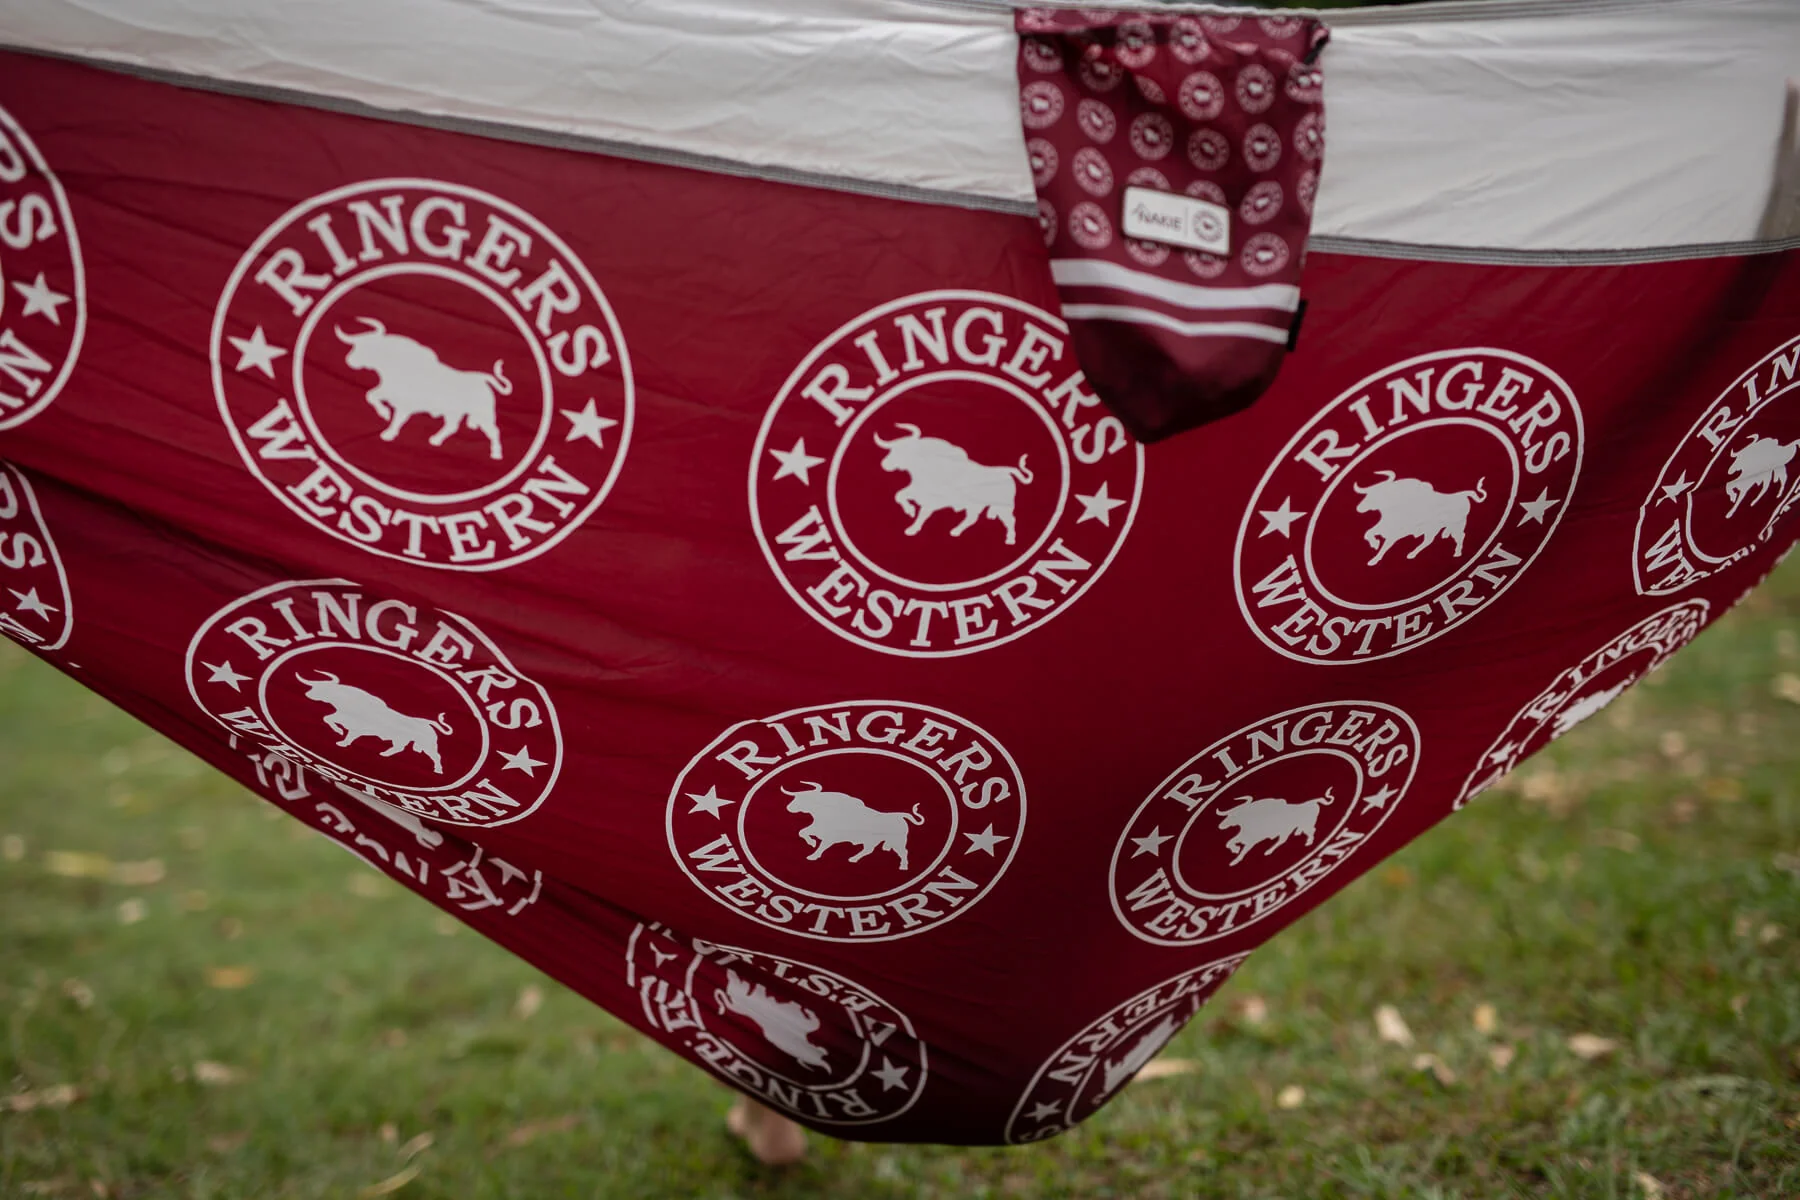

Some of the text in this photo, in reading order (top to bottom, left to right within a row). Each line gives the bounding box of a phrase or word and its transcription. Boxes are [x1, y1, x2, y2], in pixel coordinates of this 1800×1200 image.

[256, 195, 611, 377] RINGERS
[801, 306, 1128, 464] RINGERS
[1295, 361, 1571, 483] RINGERS
[246, 399, 590, 563] WESTERN
[775, 505, 1092, 648] WESTERN
[1251, 542, 1523, 657] WESTERN
[225, 591, 543, 732] RINGERS
[218, 706, 521, 823] WESTERN
[716, 710, 1011, 810] RINGERS
[1163, 710, 1409, 812] RINGERS
[688, 834, 979, 937] WESTERN
[1125, 827, 1366, 940] WESTERN
